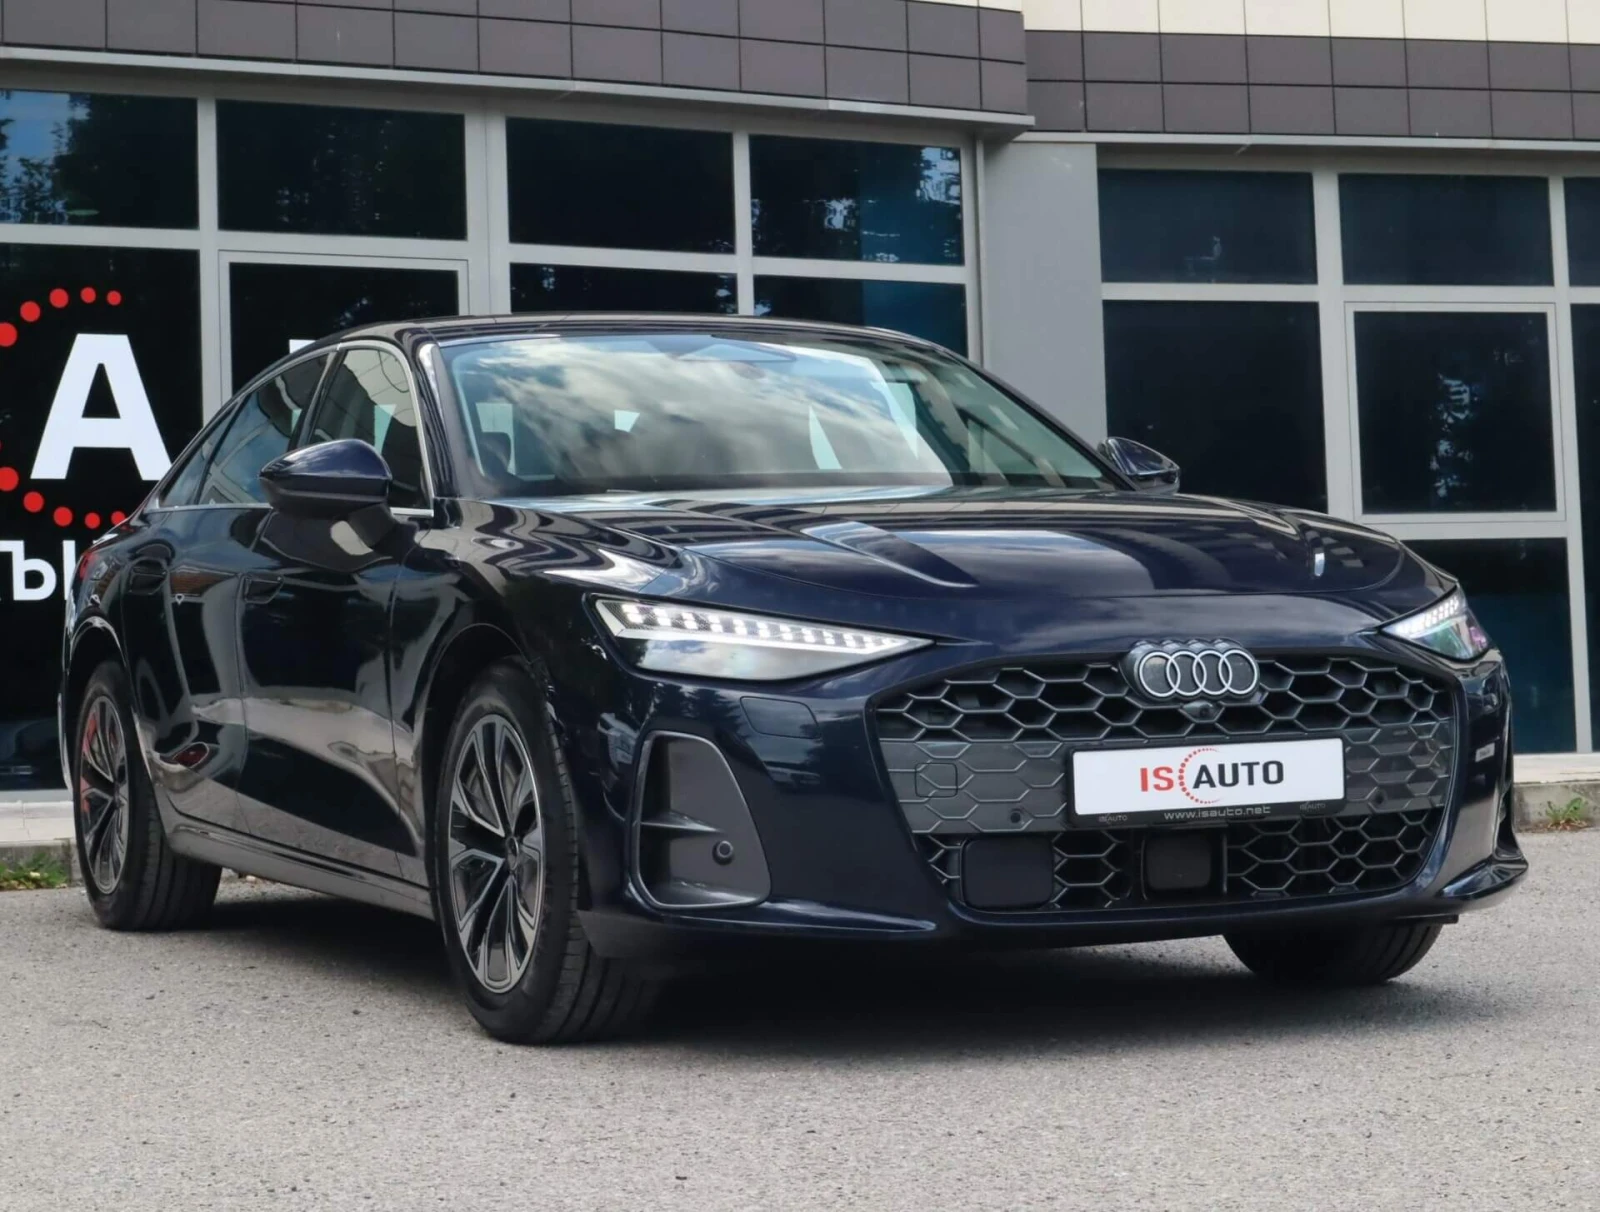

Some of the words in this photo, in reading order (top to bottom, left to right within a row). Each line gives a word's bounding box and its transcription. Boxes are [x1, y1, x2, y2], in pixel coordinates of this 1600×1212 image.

[1139, 766, 1175, 792] IS
[1192, 760, 1285, 790] AUTO
[1163, 805, 1271, 820] www.isauto.net
